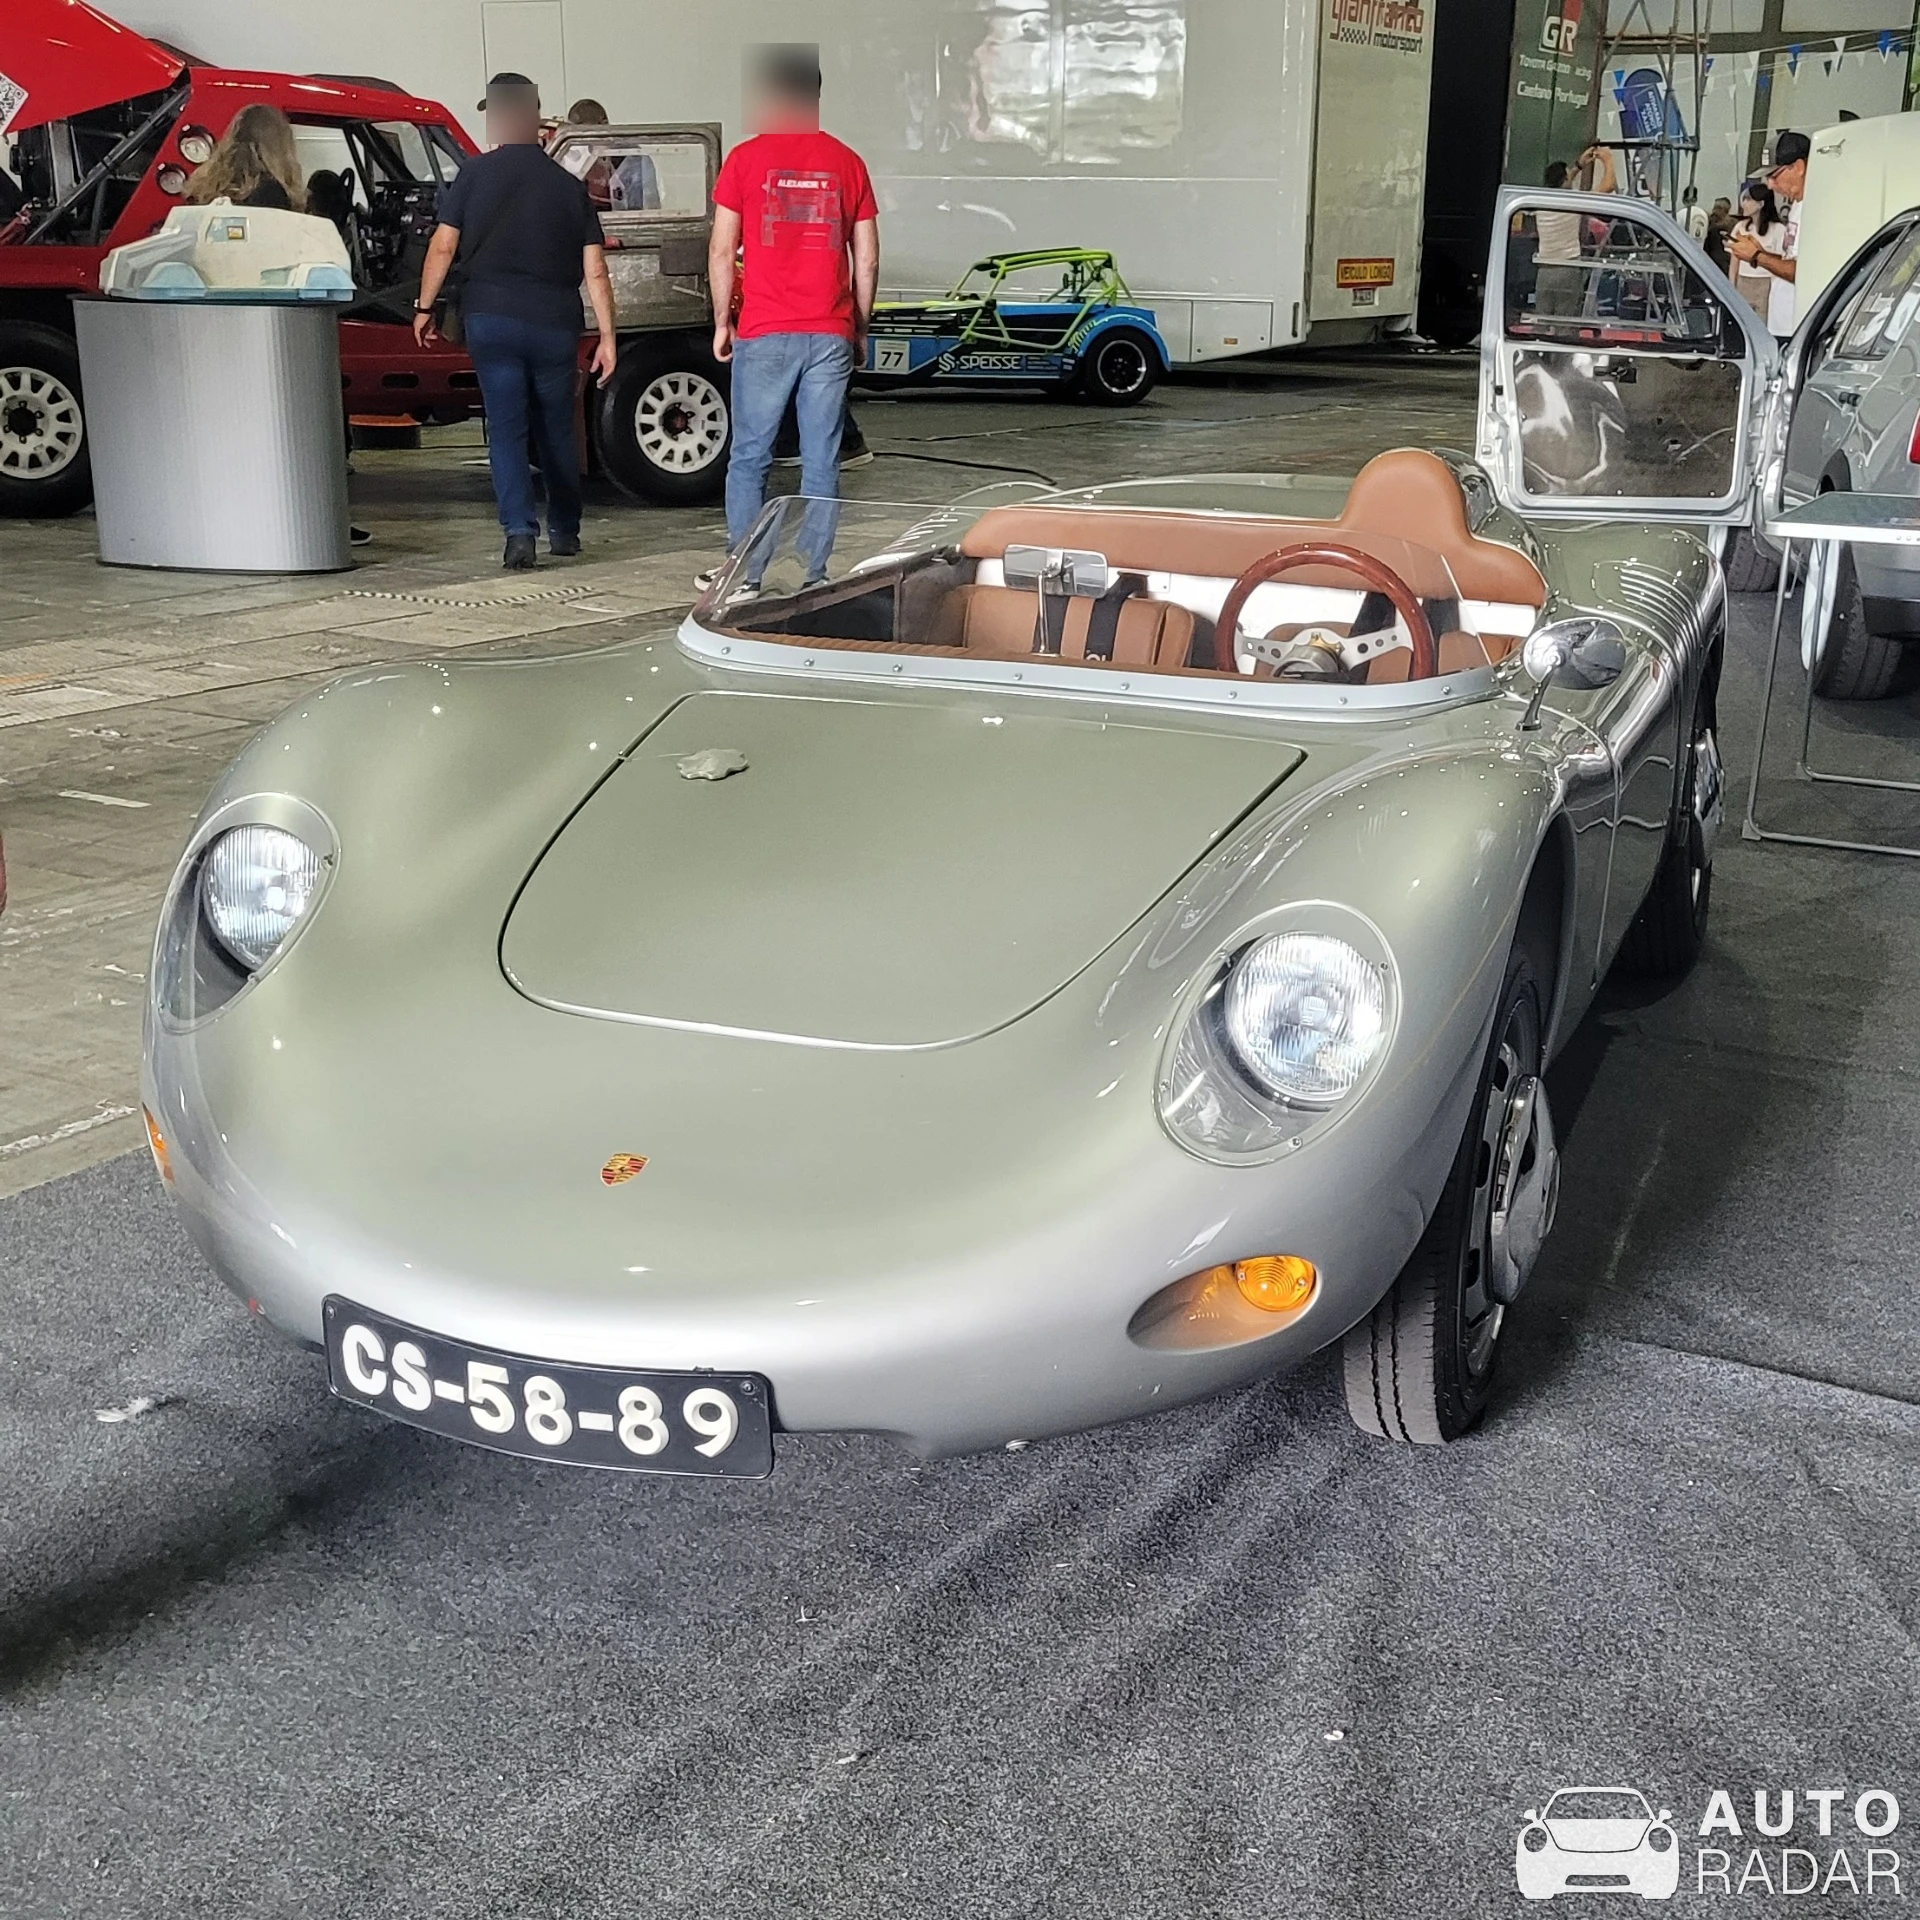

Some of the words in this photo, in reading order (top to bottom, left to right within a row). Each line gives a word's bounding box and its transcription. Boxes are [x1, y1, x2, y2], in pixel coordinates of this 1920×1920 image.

[1373, 31, 1423, 56] motorsport
[1542, 16, 1578, 52] GR
[1555, 87, 1589, 109] Portugal
[881, 351, 904, 367] 77
[341, 1323, 740, 1458] CS-58-89
